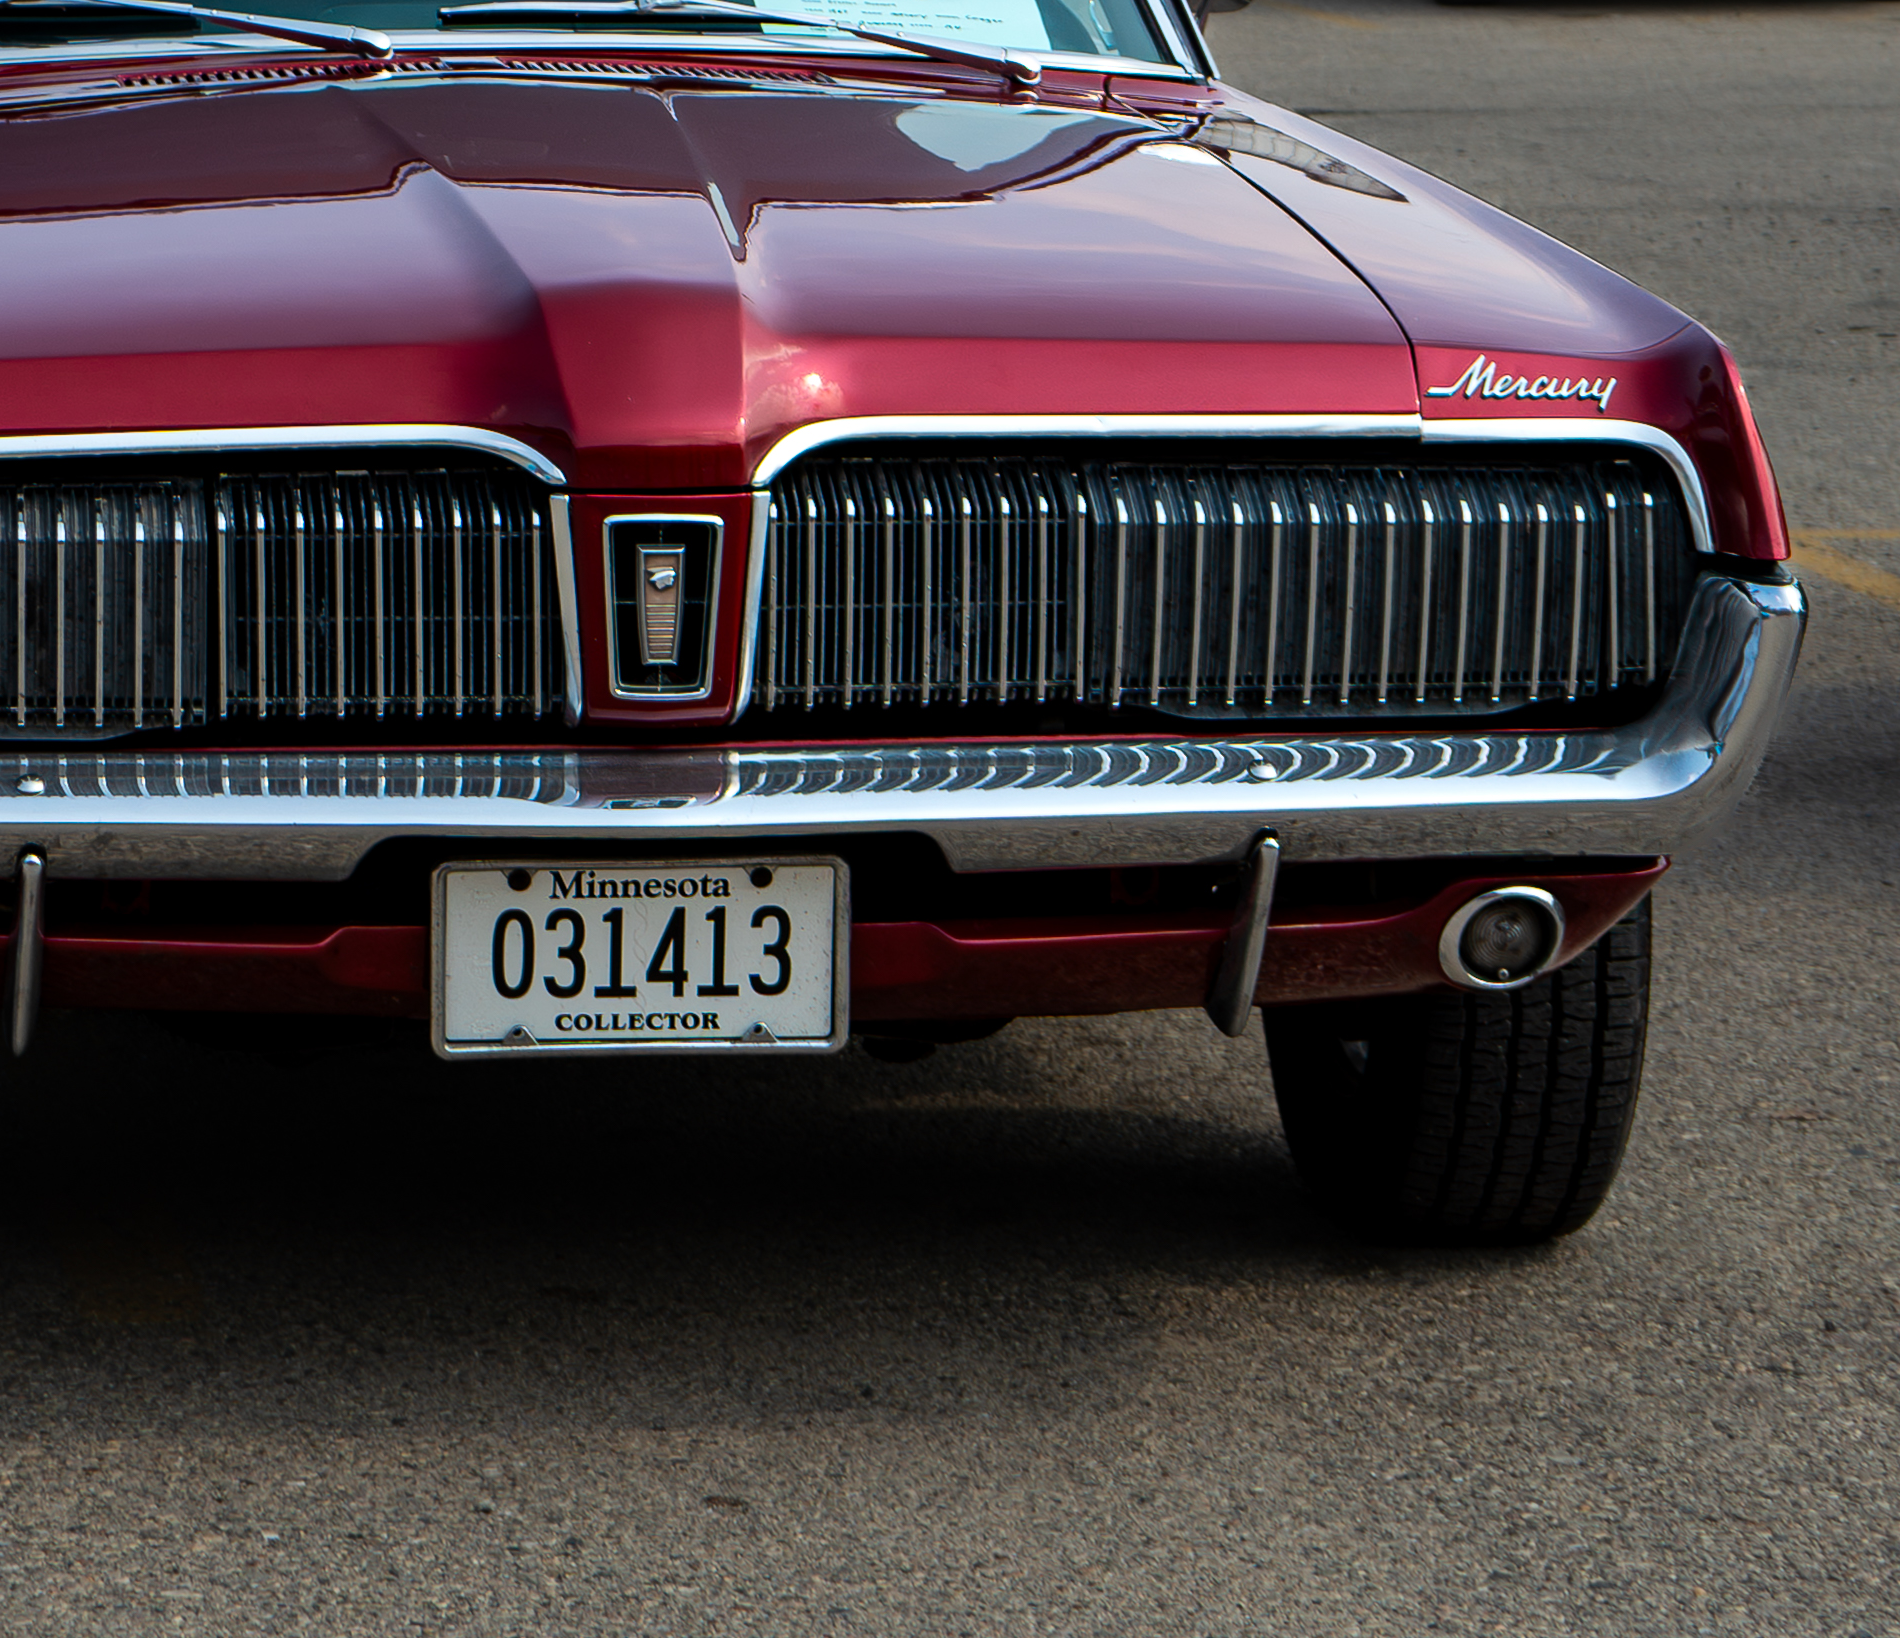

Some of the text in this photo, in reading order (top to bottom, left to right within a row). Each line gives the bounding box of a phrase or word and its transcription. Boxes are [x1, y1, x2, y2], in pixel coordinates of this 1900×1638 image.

[1424, 353, 1618, 413] Mercury
[549, 869, 731, 899] Minnesota
[491, 904, 792, 1000] 031413
[554, 1012, 721, 1031] COLLECTOR
